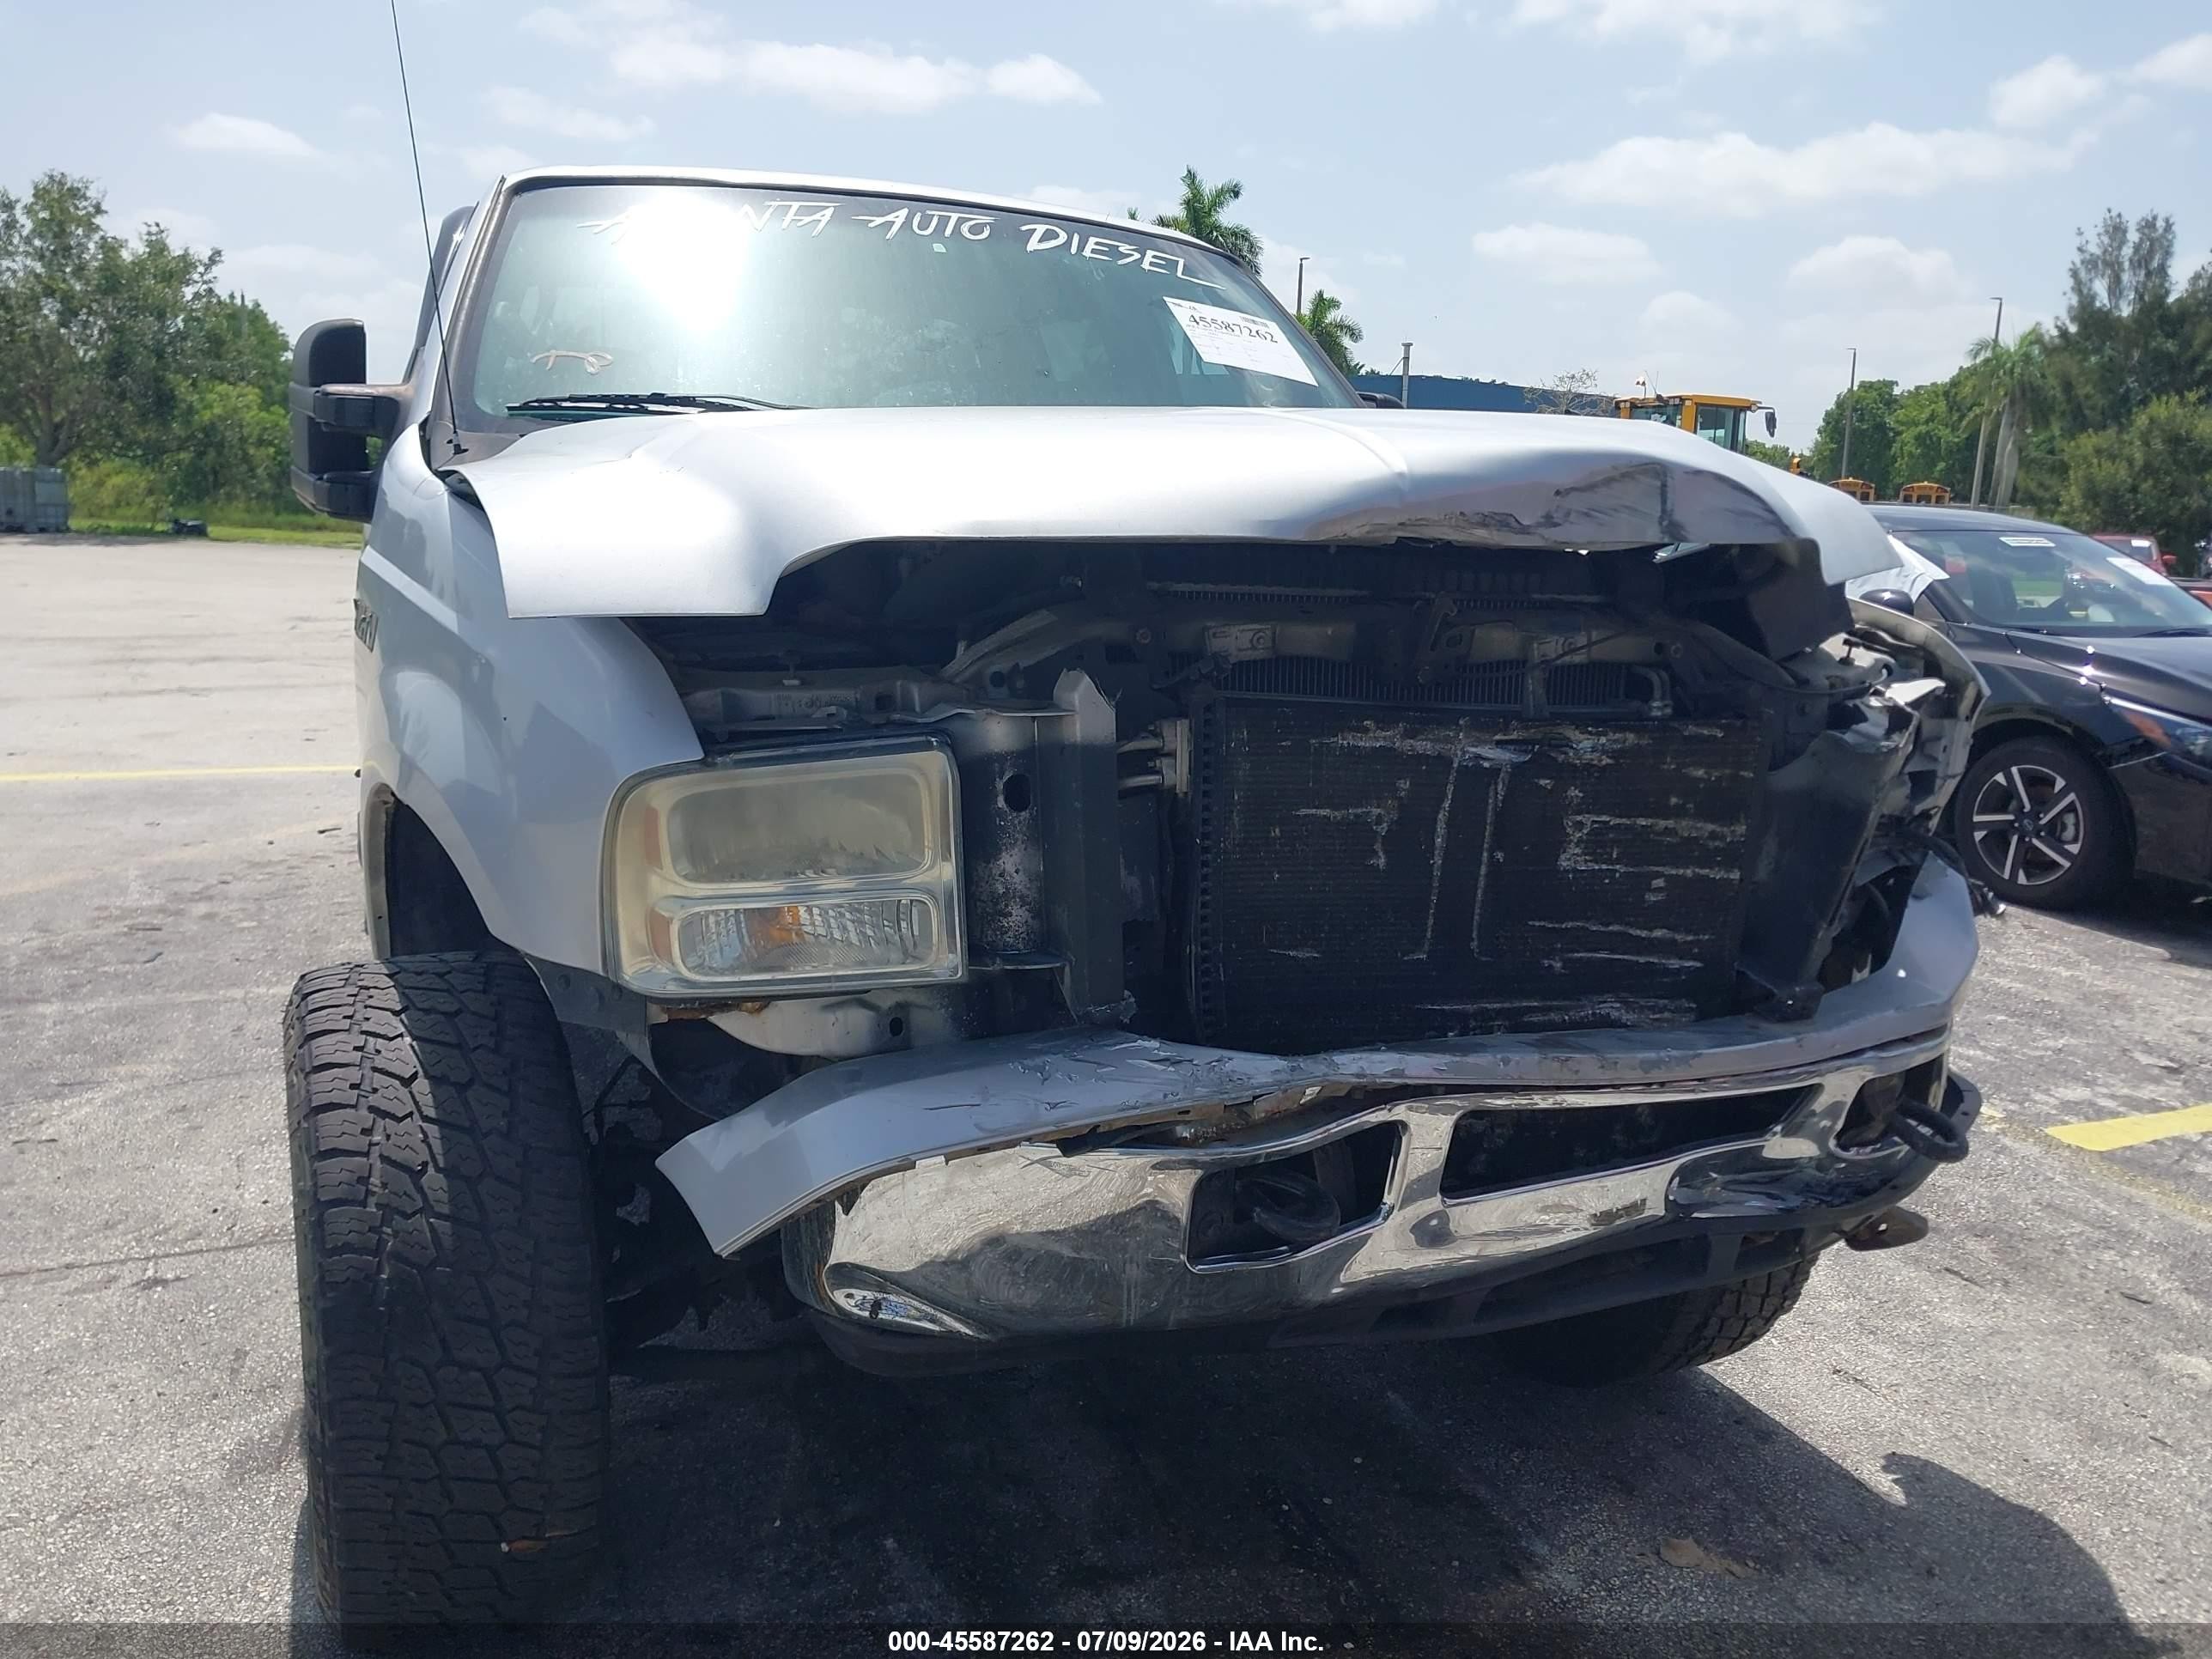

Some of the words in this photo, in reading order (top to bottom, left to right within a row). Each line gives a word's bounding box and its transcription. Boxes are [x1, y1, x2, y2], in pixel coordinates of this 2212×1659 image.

[851, 206, 1002, 241] AUTO
[1018, 223, 1228, 291] DIESEL
[1188, 313, 1279, 343] 45587262
